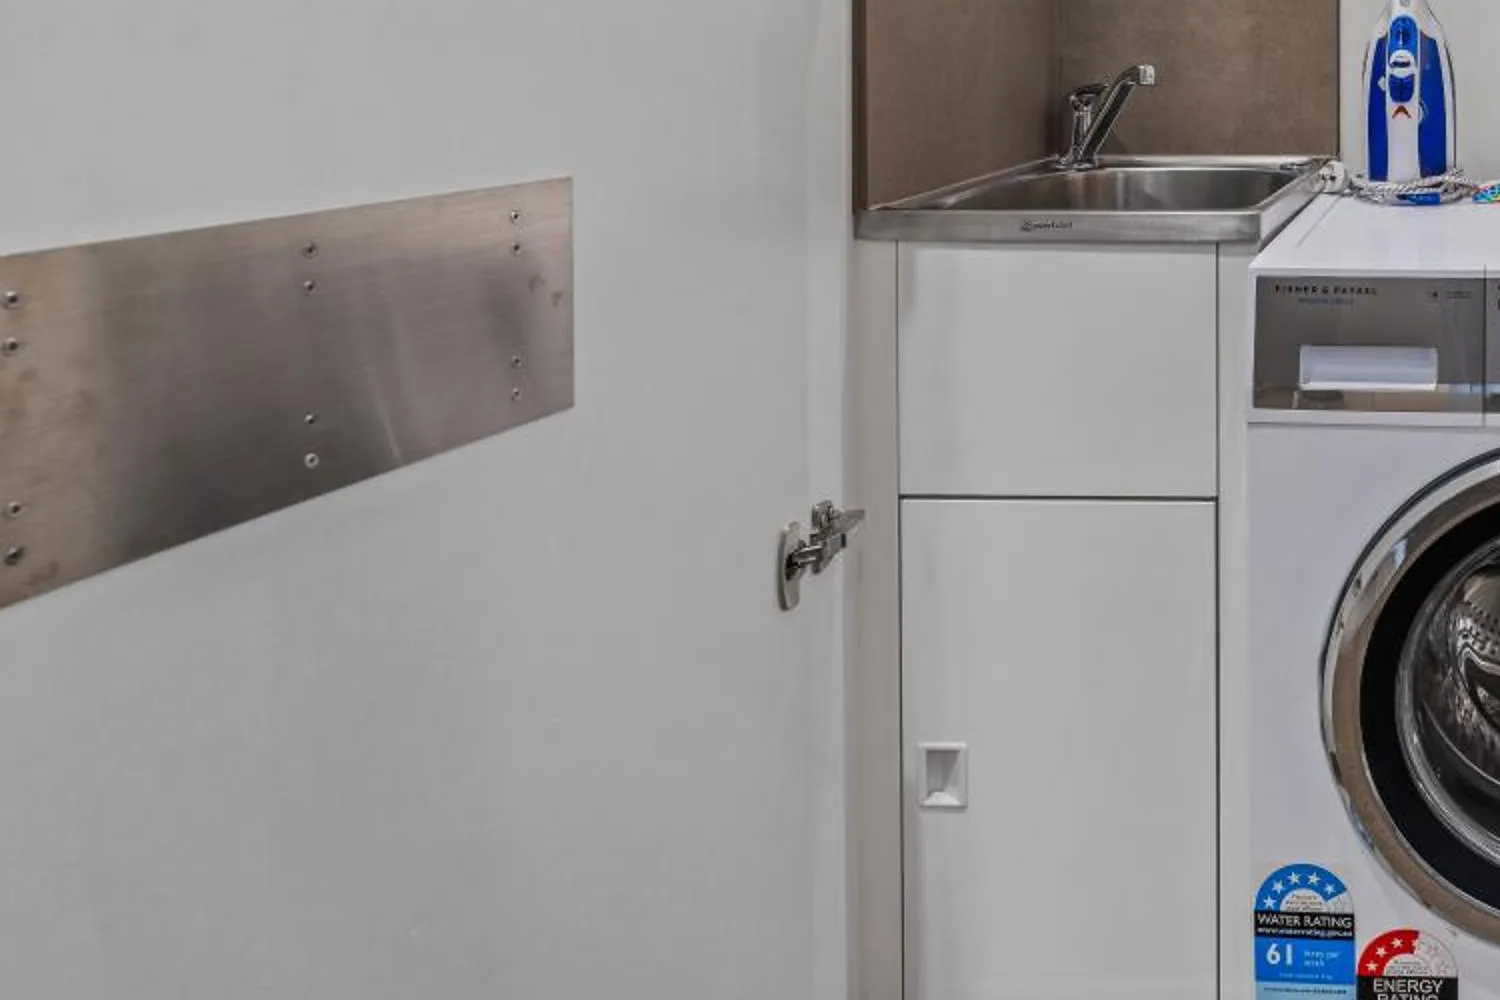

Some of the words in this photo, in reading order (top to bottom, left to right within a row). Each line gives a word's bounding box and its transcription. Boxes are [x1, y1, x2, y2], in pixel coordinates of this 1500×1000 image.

[1257, 912, 1301, 927] WATER
[1303, 914, 1353, 929] RATING
[1266, 943, 1293, 966] 61
[1373, 978, 1443, 993] ENERGY
